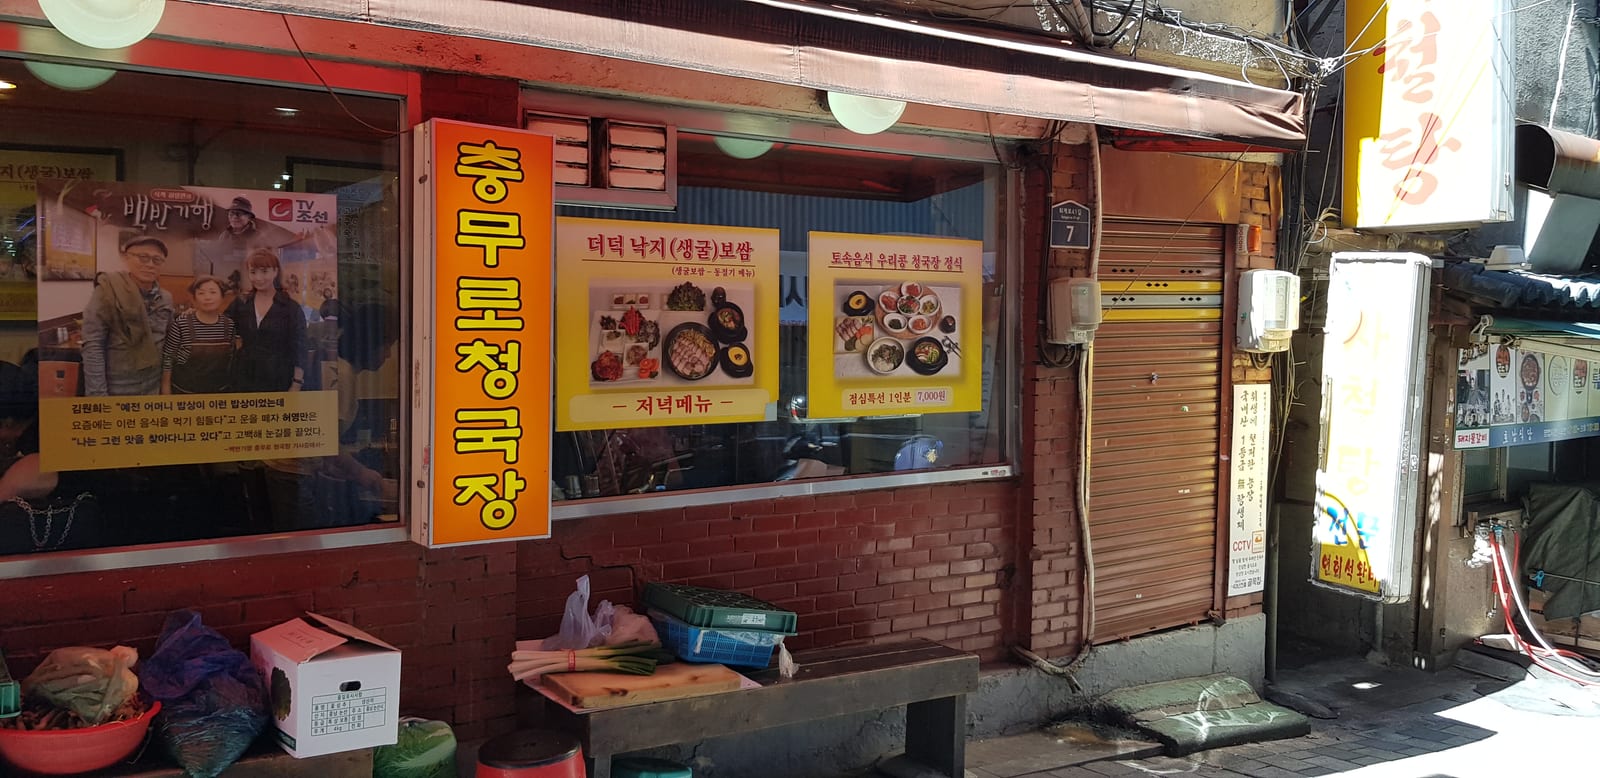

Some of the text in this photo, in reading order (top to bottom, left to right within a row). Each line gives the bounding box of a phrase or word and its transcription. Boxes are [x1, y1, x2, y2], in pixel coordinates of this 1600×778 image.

[123, 194, 214, 230] 백반기행
[296, 199, 314, 210] TV
[296, 210, 329, 223] 조선
[1066, 225, 1074, 242] 7
[587, 234, 754, 262] 더덕 낙지(생굴)보쌈
[831, 252, 963, 271] 토속음식 우리콩 청국장 정식
[453, 139, 527, 531] 충무로청국장
[72, 403, 112, 414] 김원희는
[144, 401, 173, 412] 어머니
[176, 400, 205, 411] 밥상이
[209, 399, 227, 409] 이런
[231, 398, 285, 409] 밥상이었는데
[636, 394, 713, 416] 저녁메뉴
[849, 390, 946, 405] 점심특선 1인분 7,000원
[72, 420, 112, 430] 요즘에는
[116, 418, 136, 429] 이런
[140, 416, 169, 428] 음식을
[173, 416, 192, 427] 먹기
[240, 414, 258, 425] 운을
[282, 411, 317, 423] 허영만은
[101, 435, 121, 446] 그런
[124, 434, 145, 445] 맛을
[148, 433, 197, 444] 찾아다니고
[236, 429, 262, 439] 고백해
[1232, 540, 1251, 551] CCTV
